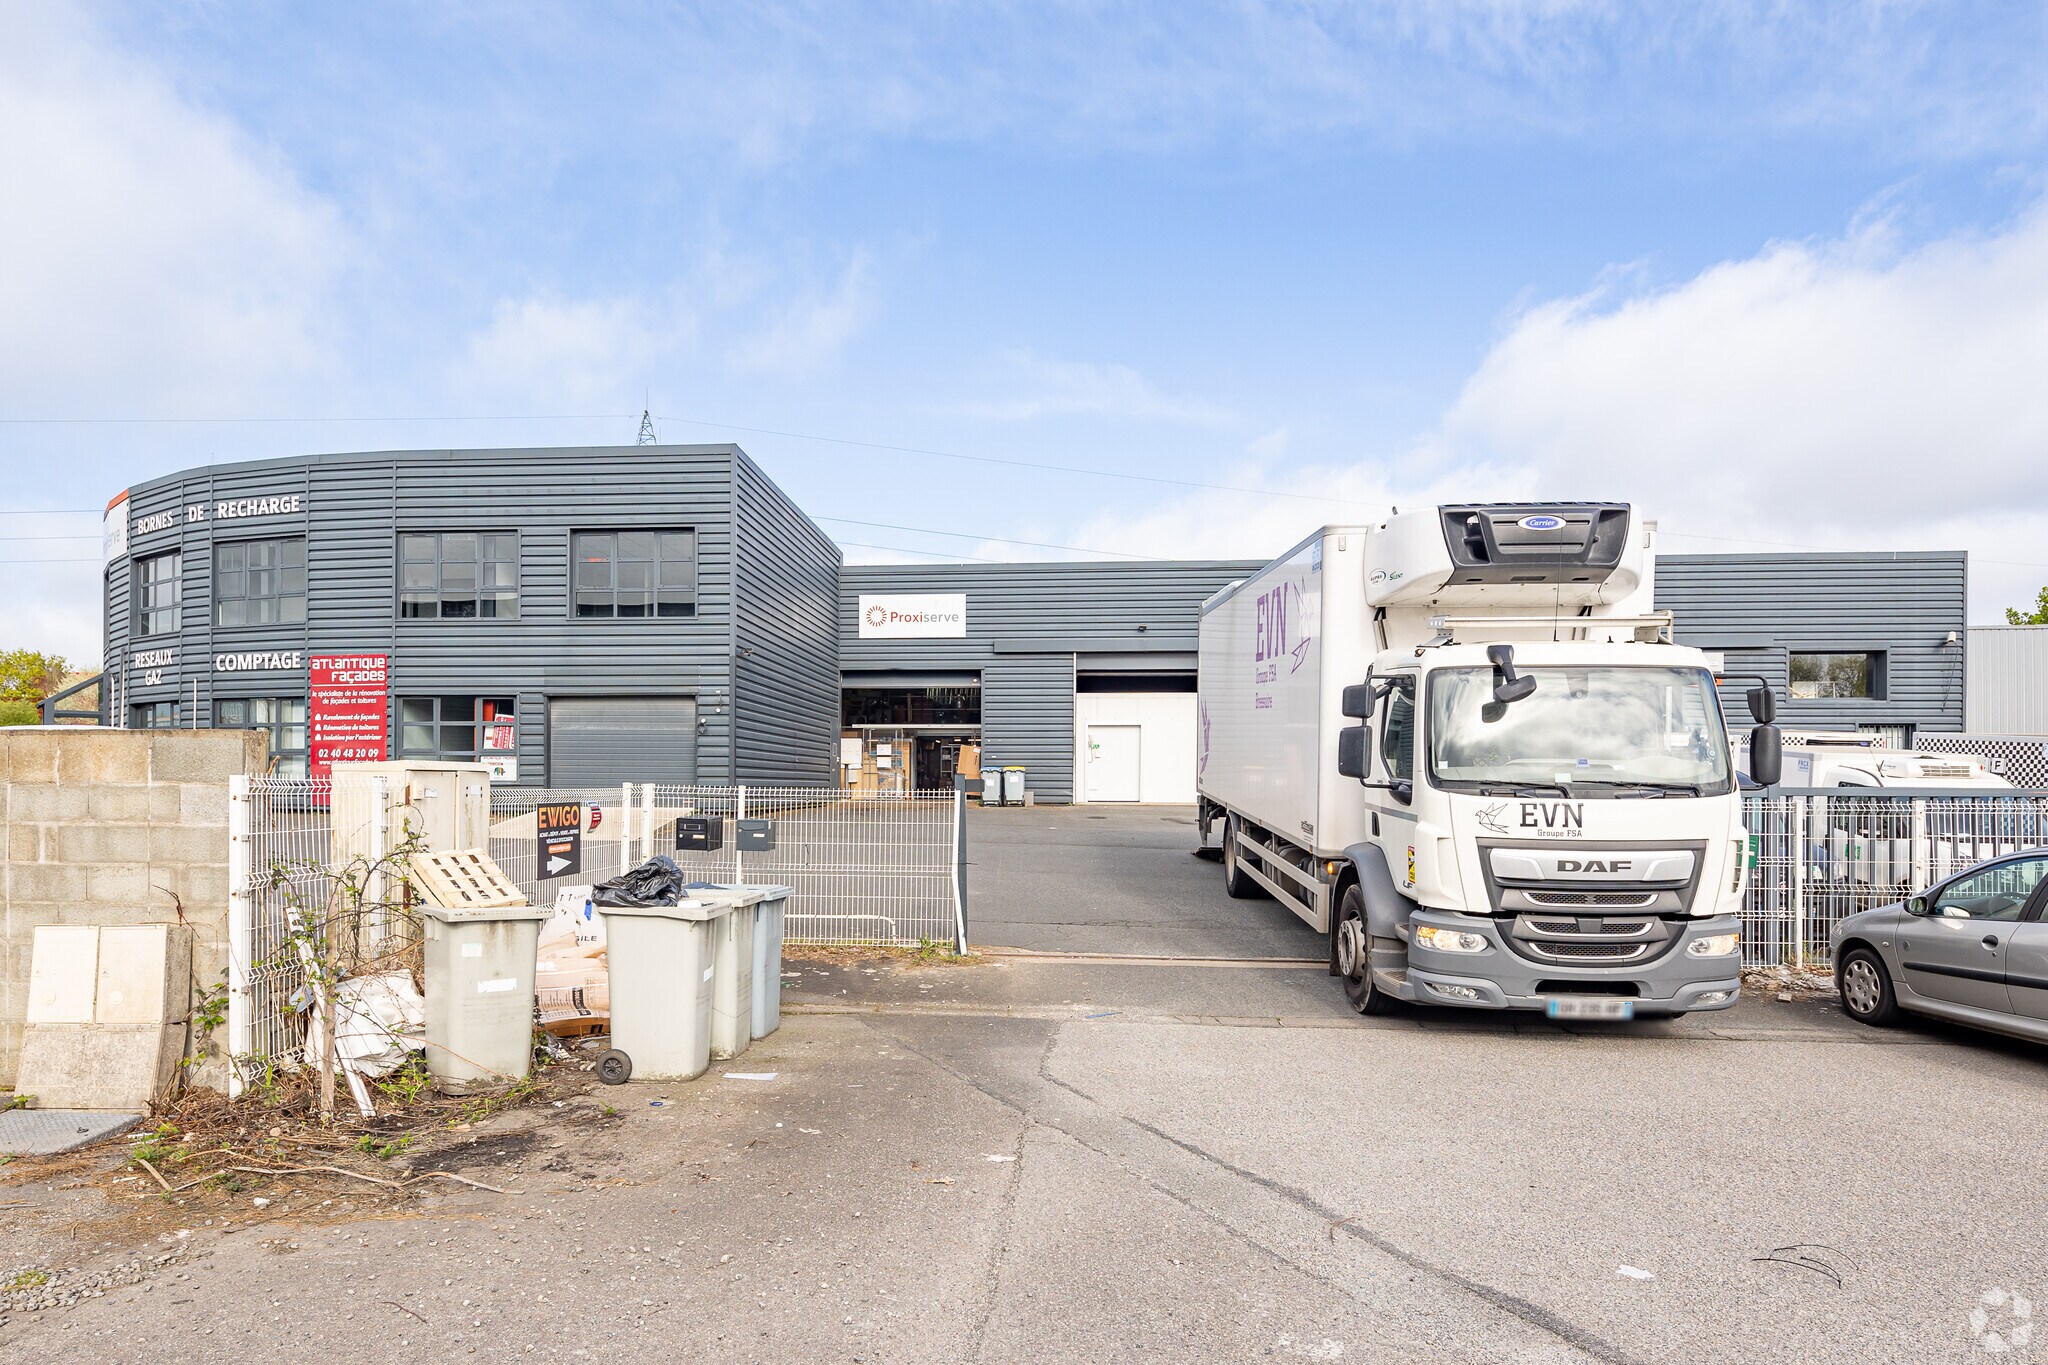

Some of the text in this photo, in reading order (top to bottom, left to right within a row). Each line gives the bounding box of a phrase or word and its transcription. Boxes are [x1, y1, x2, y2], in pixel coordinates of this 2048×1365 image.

[137, 495, 300, 535] BORNES DE RECHARGE
[890, 611, 959, 623] Proxiserve
[1256, 581, 1288, 662] EVN
[135, 649, 173, 668] RESEAUX
[215, 652, 300, 671] COMPTAGE
[145, 669, 162, 686] GAZ
[318, 748, 379, 758] 02 40 48 20 09
[538, 805, 580, 829] EWIGO
[1520, 802, 1584, 828] EVN
[1537, 829, 1583, 838] Groupe FSA
[1557, 860, 1632, 873] DAF
